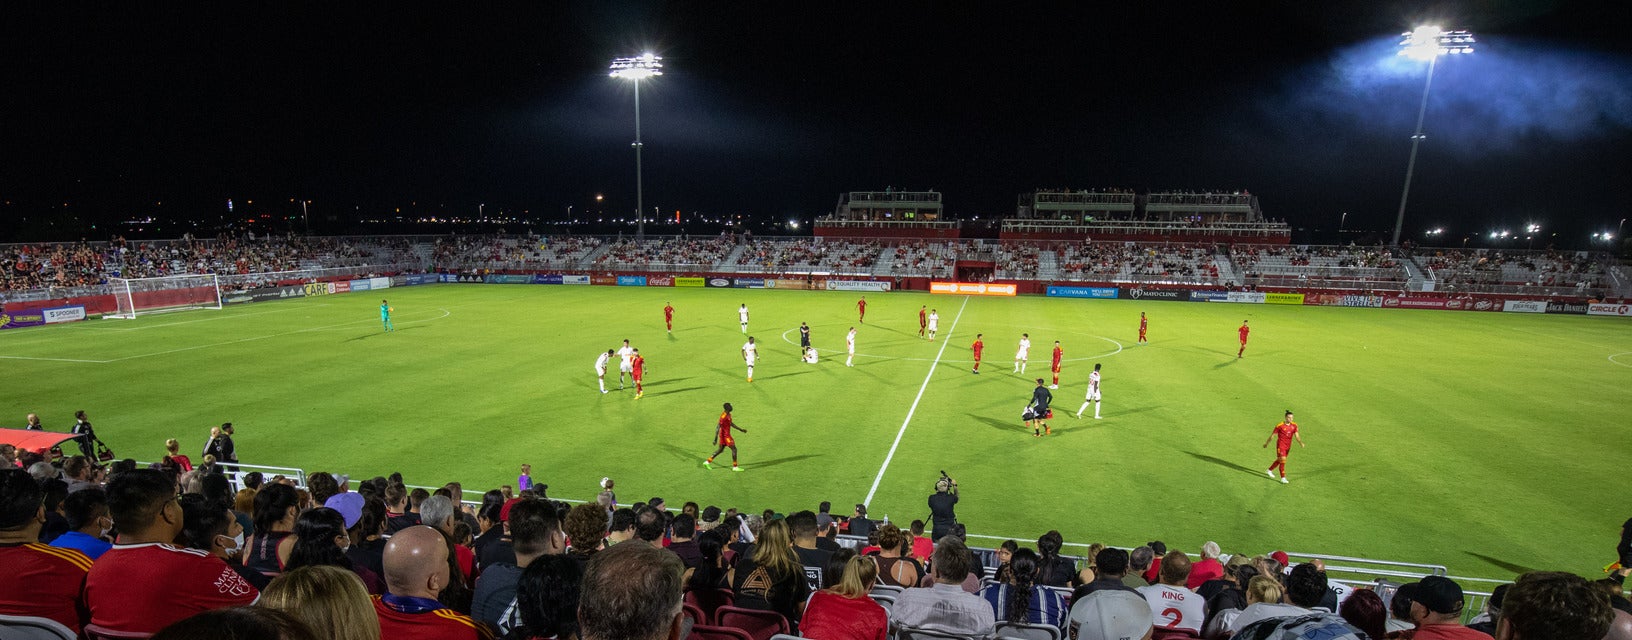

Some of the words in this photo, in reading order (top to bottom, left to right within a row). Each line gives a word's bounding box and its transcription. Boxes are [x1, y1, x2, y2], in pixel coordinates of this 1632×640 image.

[649, 278, 671, 286] Coca-Cola
[1548, 302, 1563, 311] JACK
[1618, 305, 1628, 314] K
[1162, 590, 1185, 602] KING
[1160, 607, 1183, 629] 2
